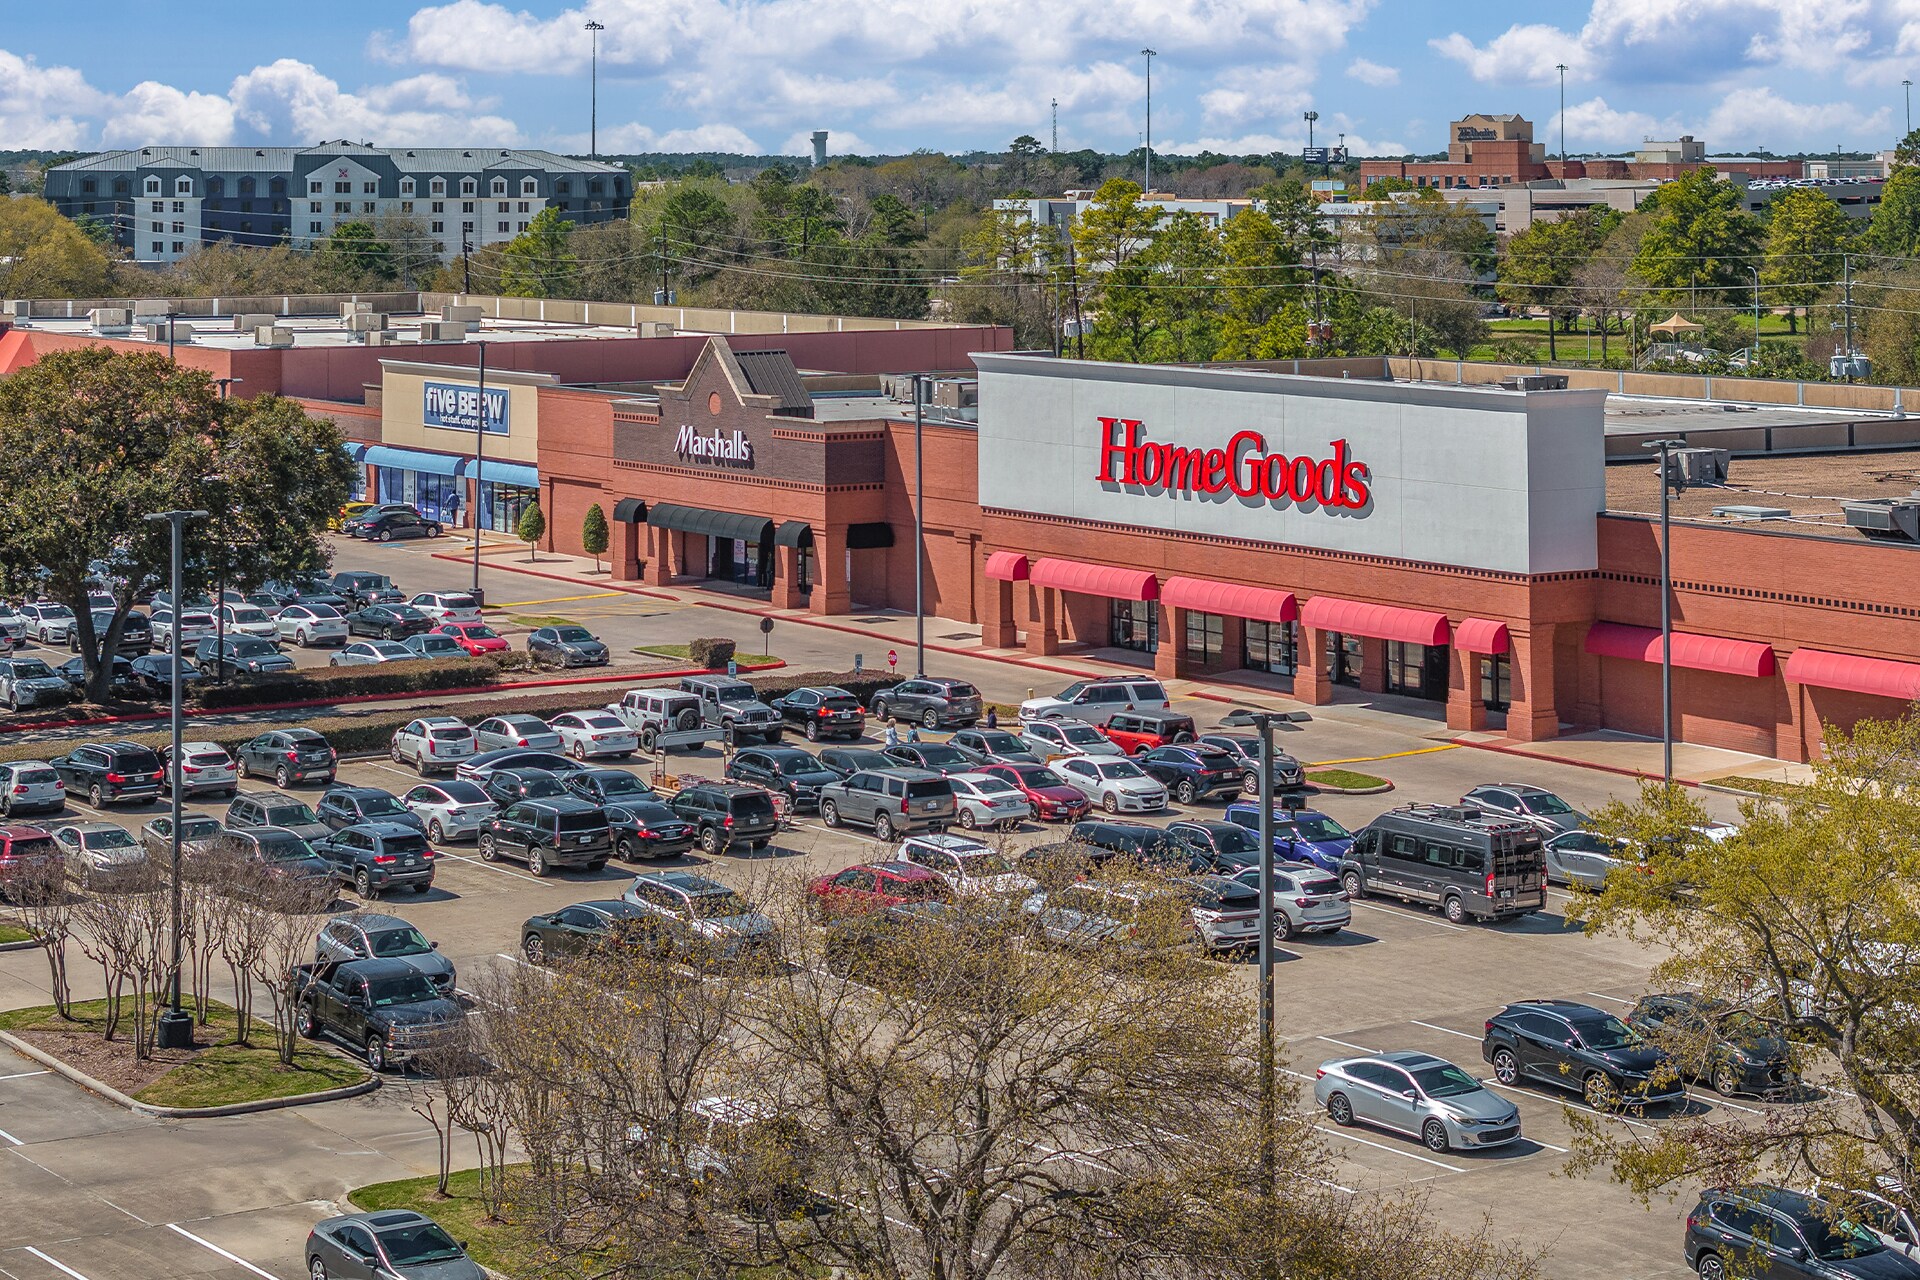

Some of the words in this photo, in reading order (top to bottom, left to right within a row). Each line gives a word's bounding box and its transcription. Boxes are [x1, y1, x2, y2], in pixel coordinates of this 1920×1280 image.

[426, 387, 456, 414] five
[674, 425, 750, 461] Marshalls
[1095, 416, 1370, 509] HomeGoods
